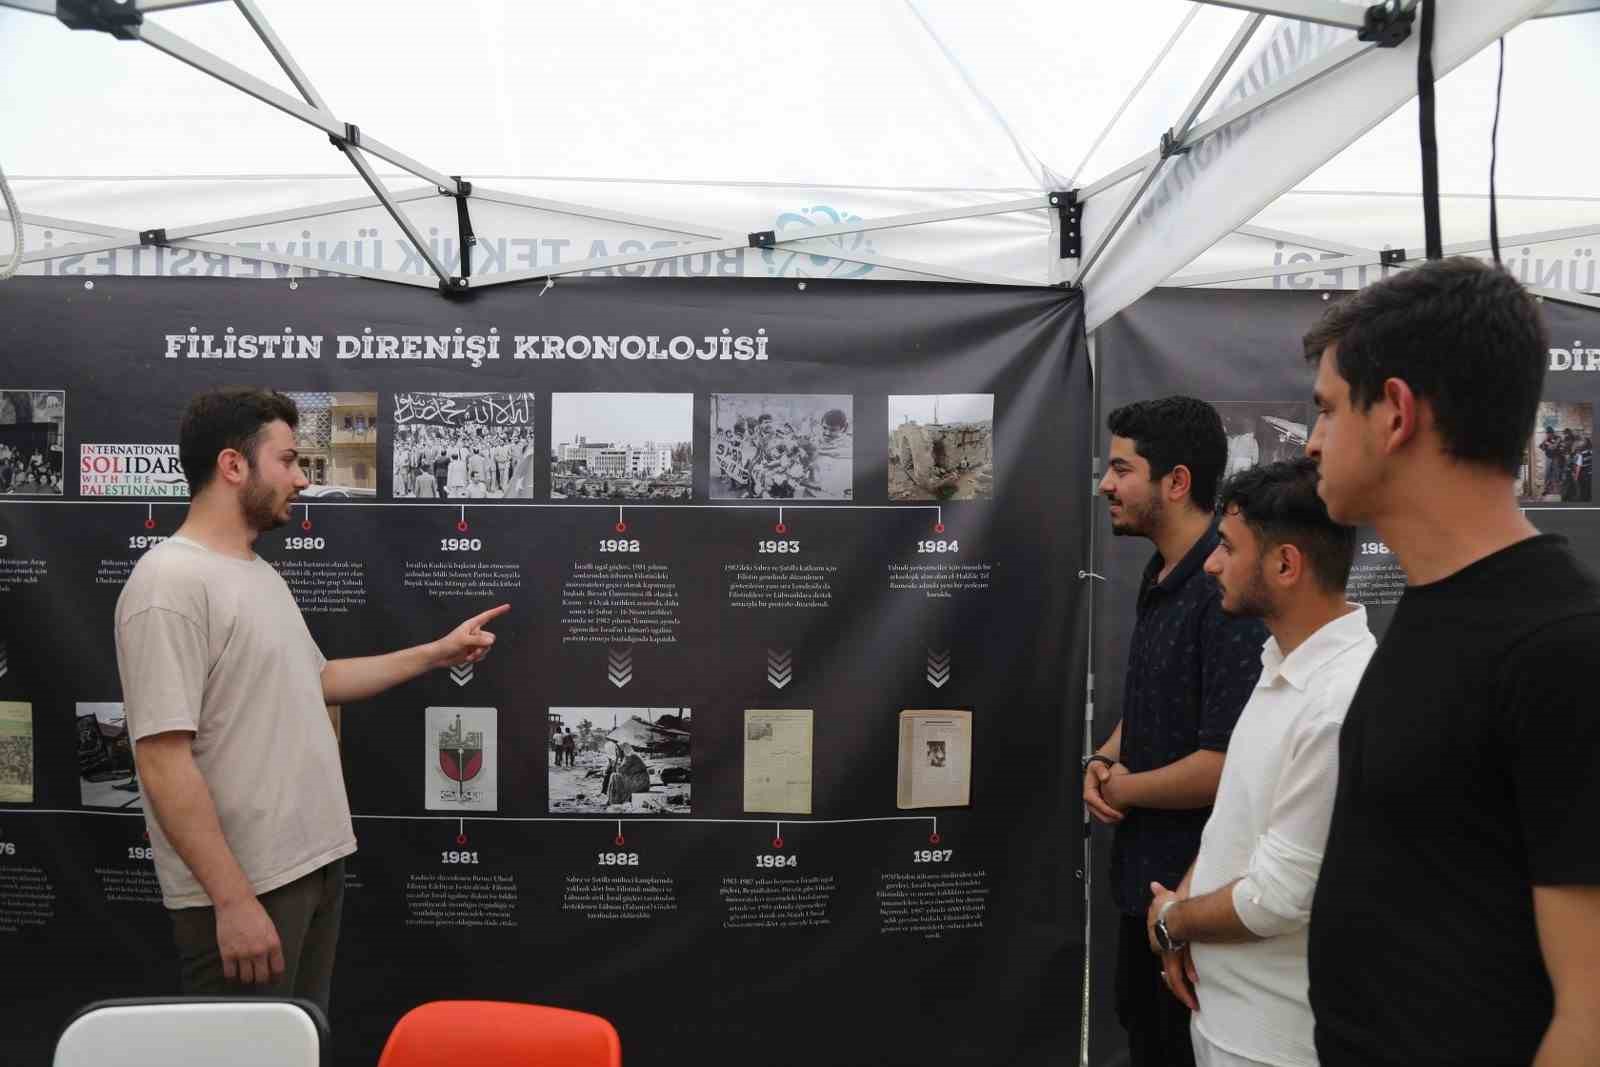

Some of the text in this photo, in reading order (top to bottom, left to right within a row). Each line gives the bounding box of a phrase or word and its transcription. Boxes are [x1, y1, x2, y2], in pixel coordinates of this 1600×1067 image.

[165, 327, 769, 368] FİLİSTİN DİRENİŞİ KRONOLOJİSİ
[82, 445, 177, 455] INTERNATIONAL
[82, 456, 183, 474] SOLIDAR
[82, 475, 150, 483] WITH THE
[82, 485, 168, 496] PALESTINIAN
[285, 537, 325, 550] 1980
[441, 538, 482, 551] 1980
[600, 539, 640, 552] 1982
[758, 540, 800, 553] 1983
[917, 540, 959, 553] 1984
[441, 851, 479, 864] 1981
[598, 852, 639, 866] 1982
[756, 854, 797, 868] 1984
[913, 849, 952, 863] 1987
